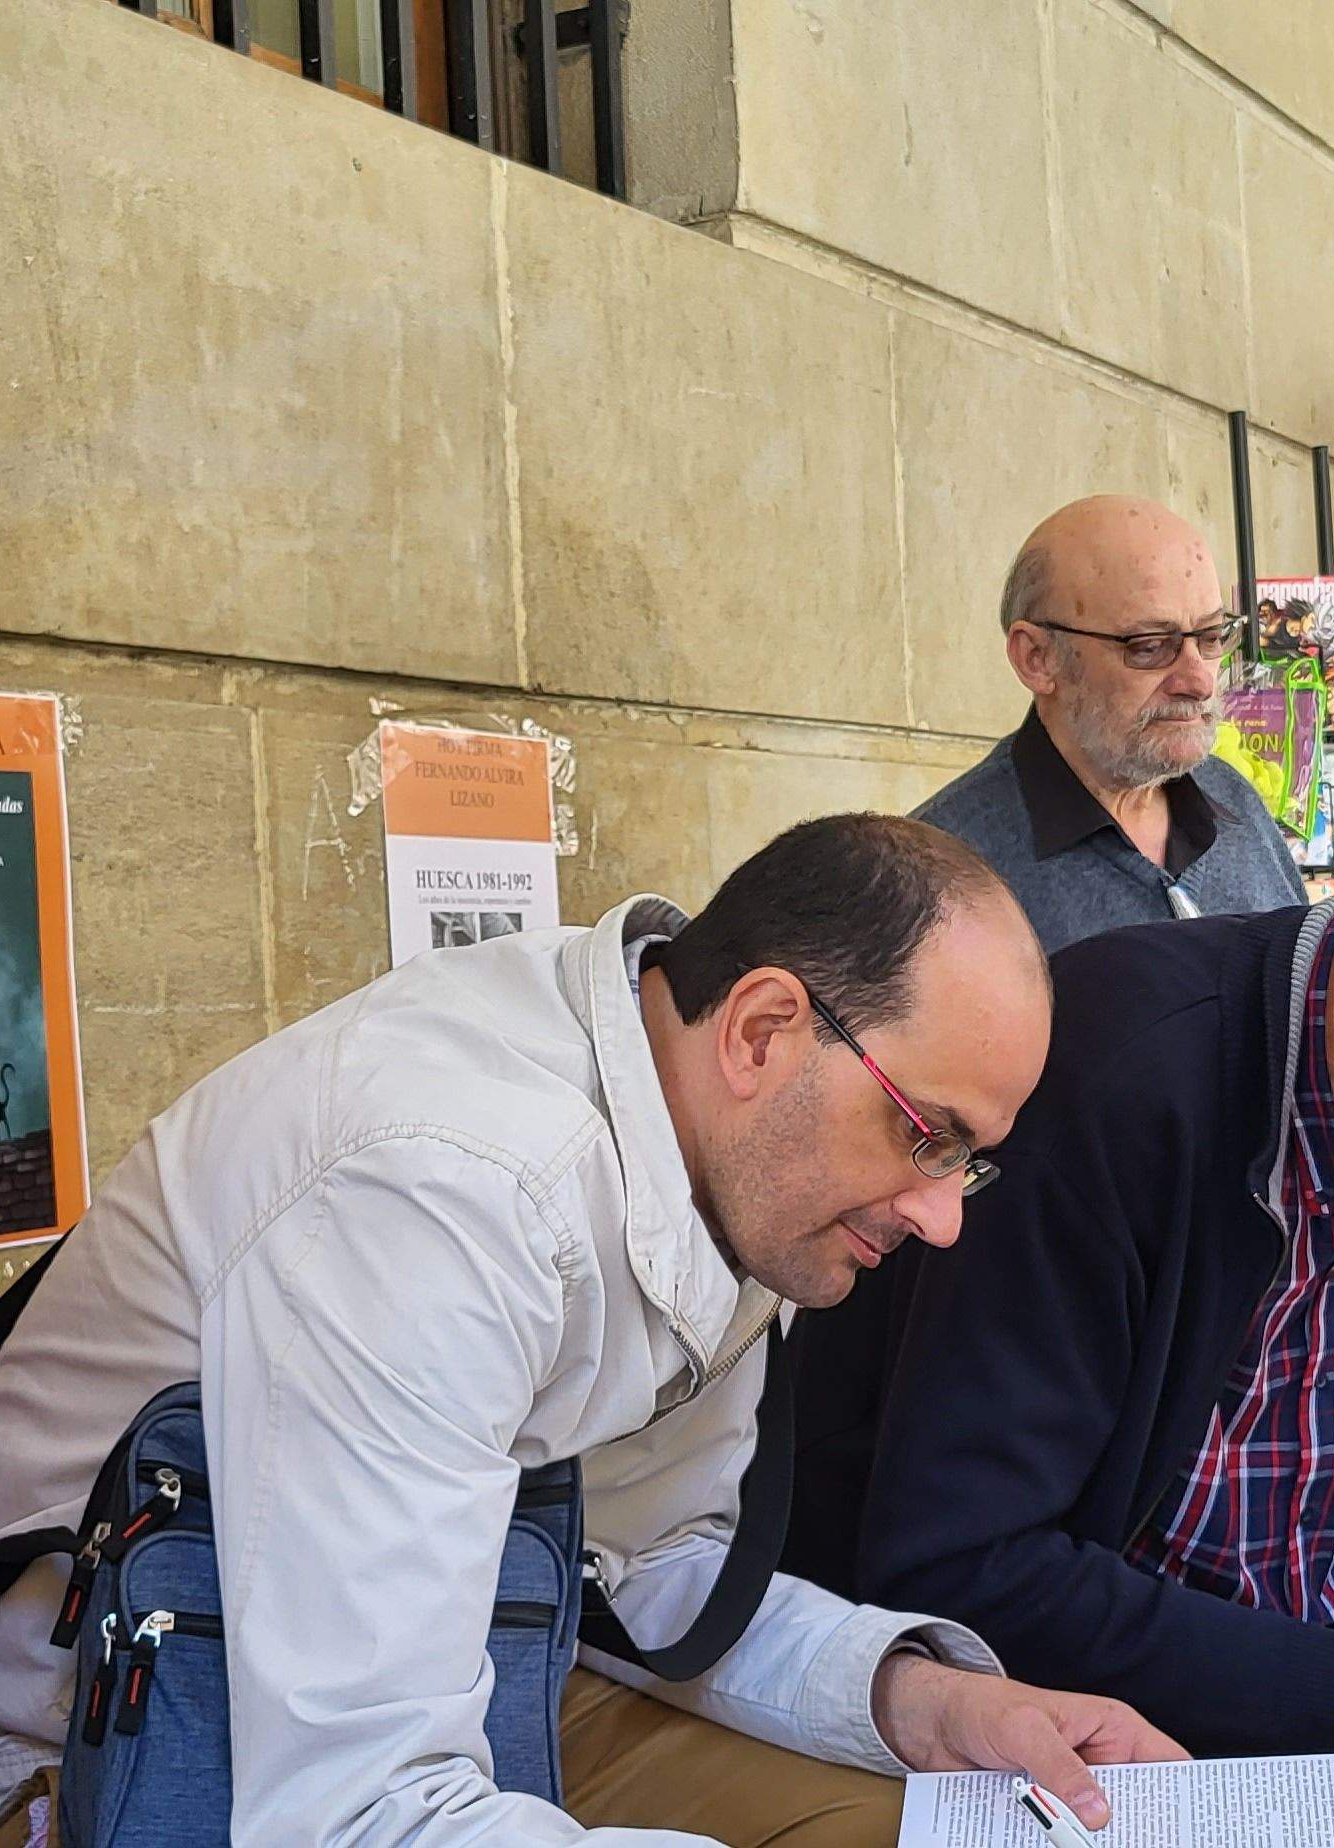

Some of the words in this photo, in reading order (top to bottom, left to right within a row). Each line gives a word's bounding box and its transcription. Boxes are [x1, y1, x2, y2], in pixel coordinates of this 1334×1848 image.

[415, 761, 482, 781] FERNANDO
[484, 767, 524, 786] ALVIRA
[450, 790, 495, 808] LIZANO
[416, 869, 474, 890] HUESCA
[476, 871, 533, 891] 1981-1992
